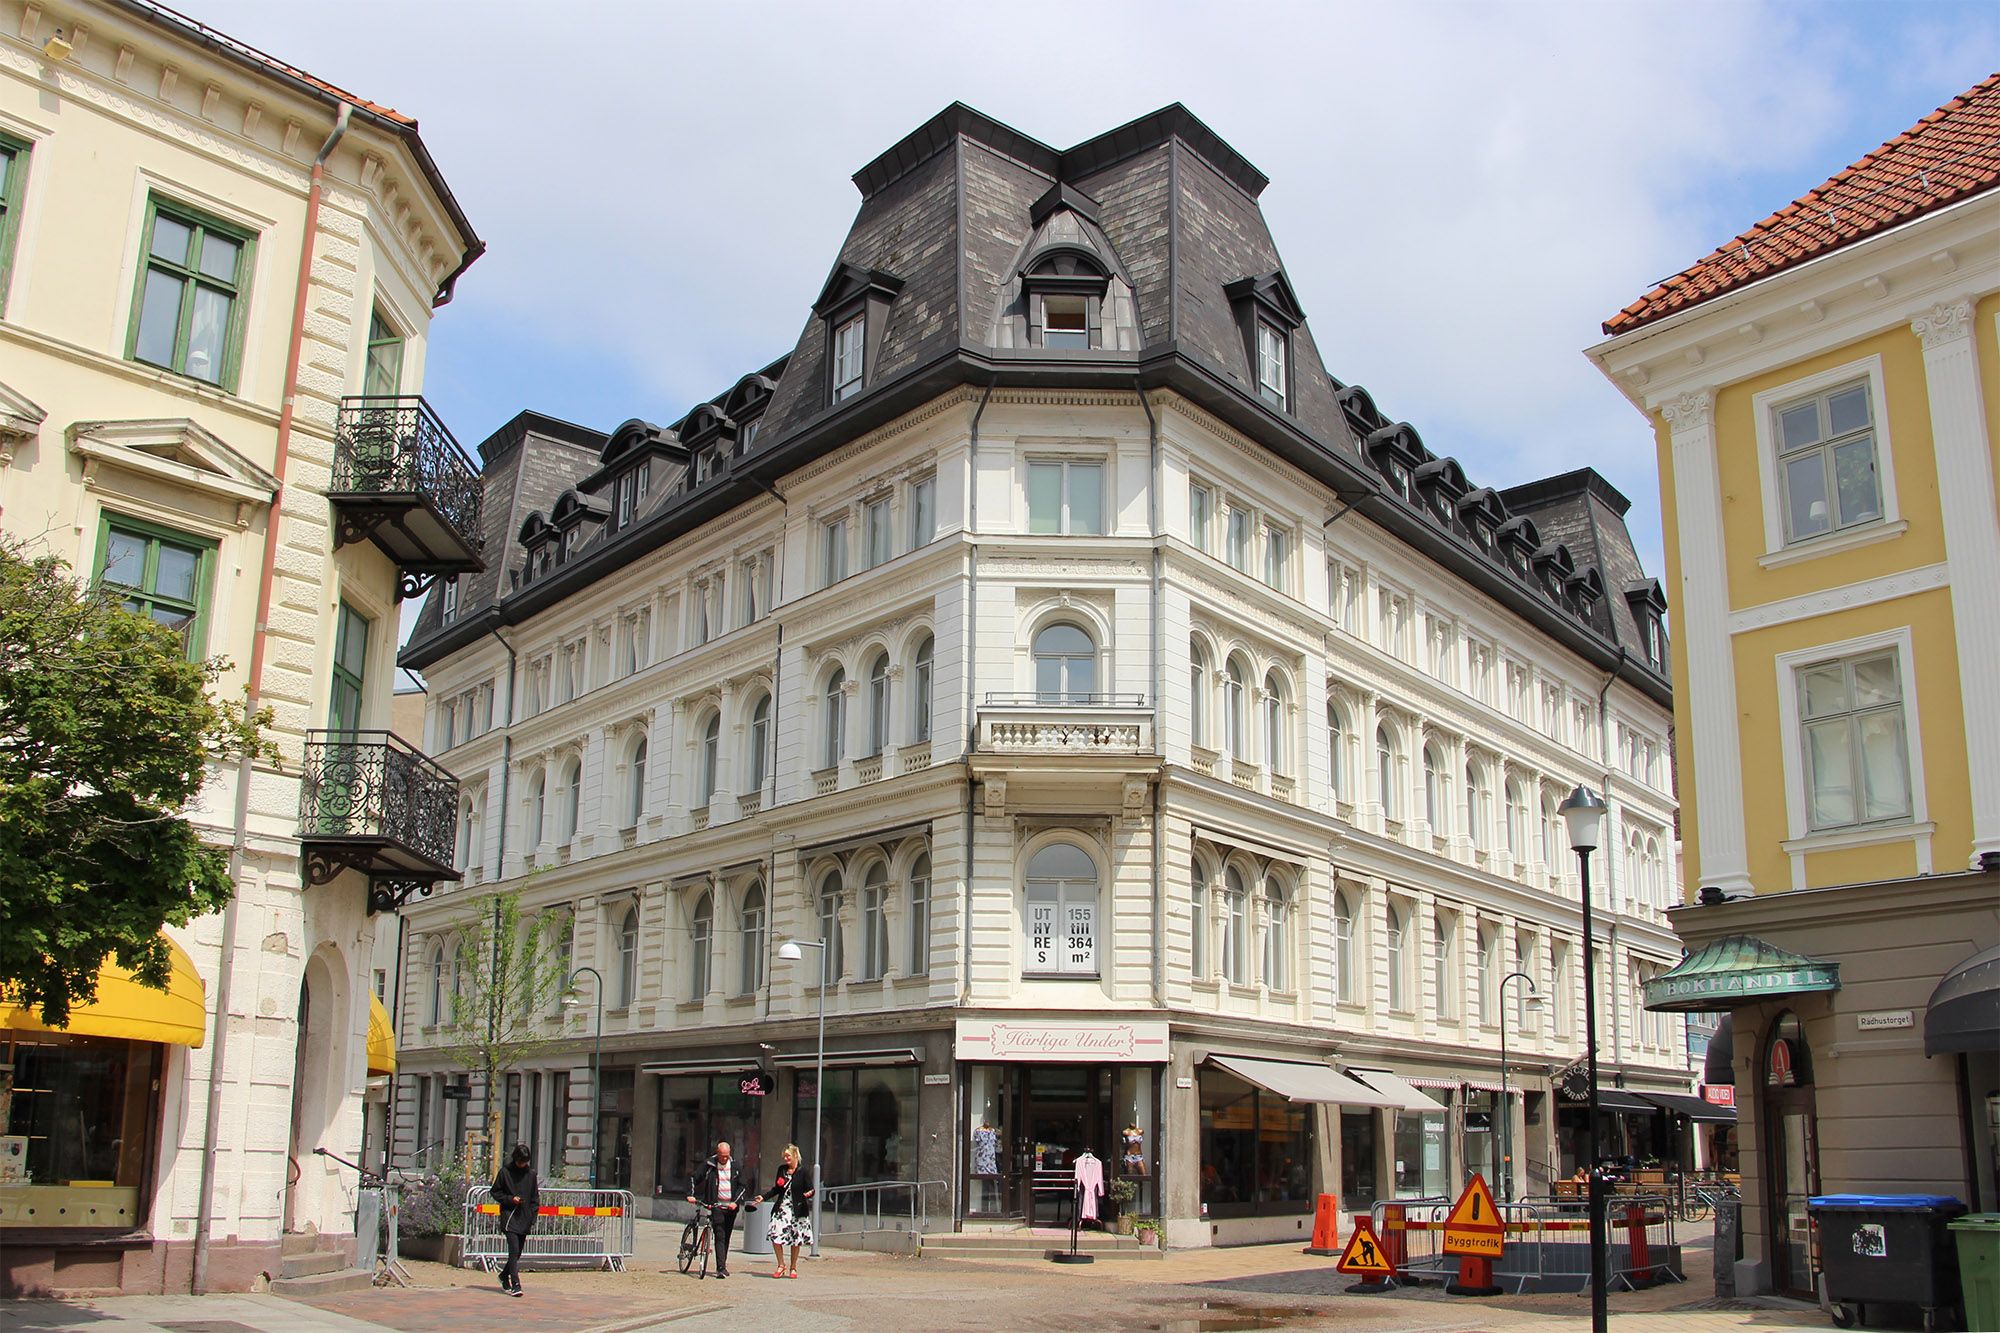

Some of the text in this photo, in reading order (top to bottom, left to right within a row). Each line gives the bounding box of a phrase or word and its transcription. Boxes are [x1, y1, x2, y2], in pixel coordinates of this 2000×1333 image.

[1034, 908, 1051, 920] UT
[1068, 908, 1091, 920] 155
[1034, 923, 1051, 934] HY
[1071, 923, 1089, 934] till
[1034, 937, 1051, 948] RE
[1068, 937, 1093, 949] 364
[1038, 951, 1046, 963] S
[1861, 1016, 1909, 1026] Rådhustorget
[1002, 1030, 1124, 1051] Härliga Under
[1447, 1235, 1499, 1248] Byggtrafik
